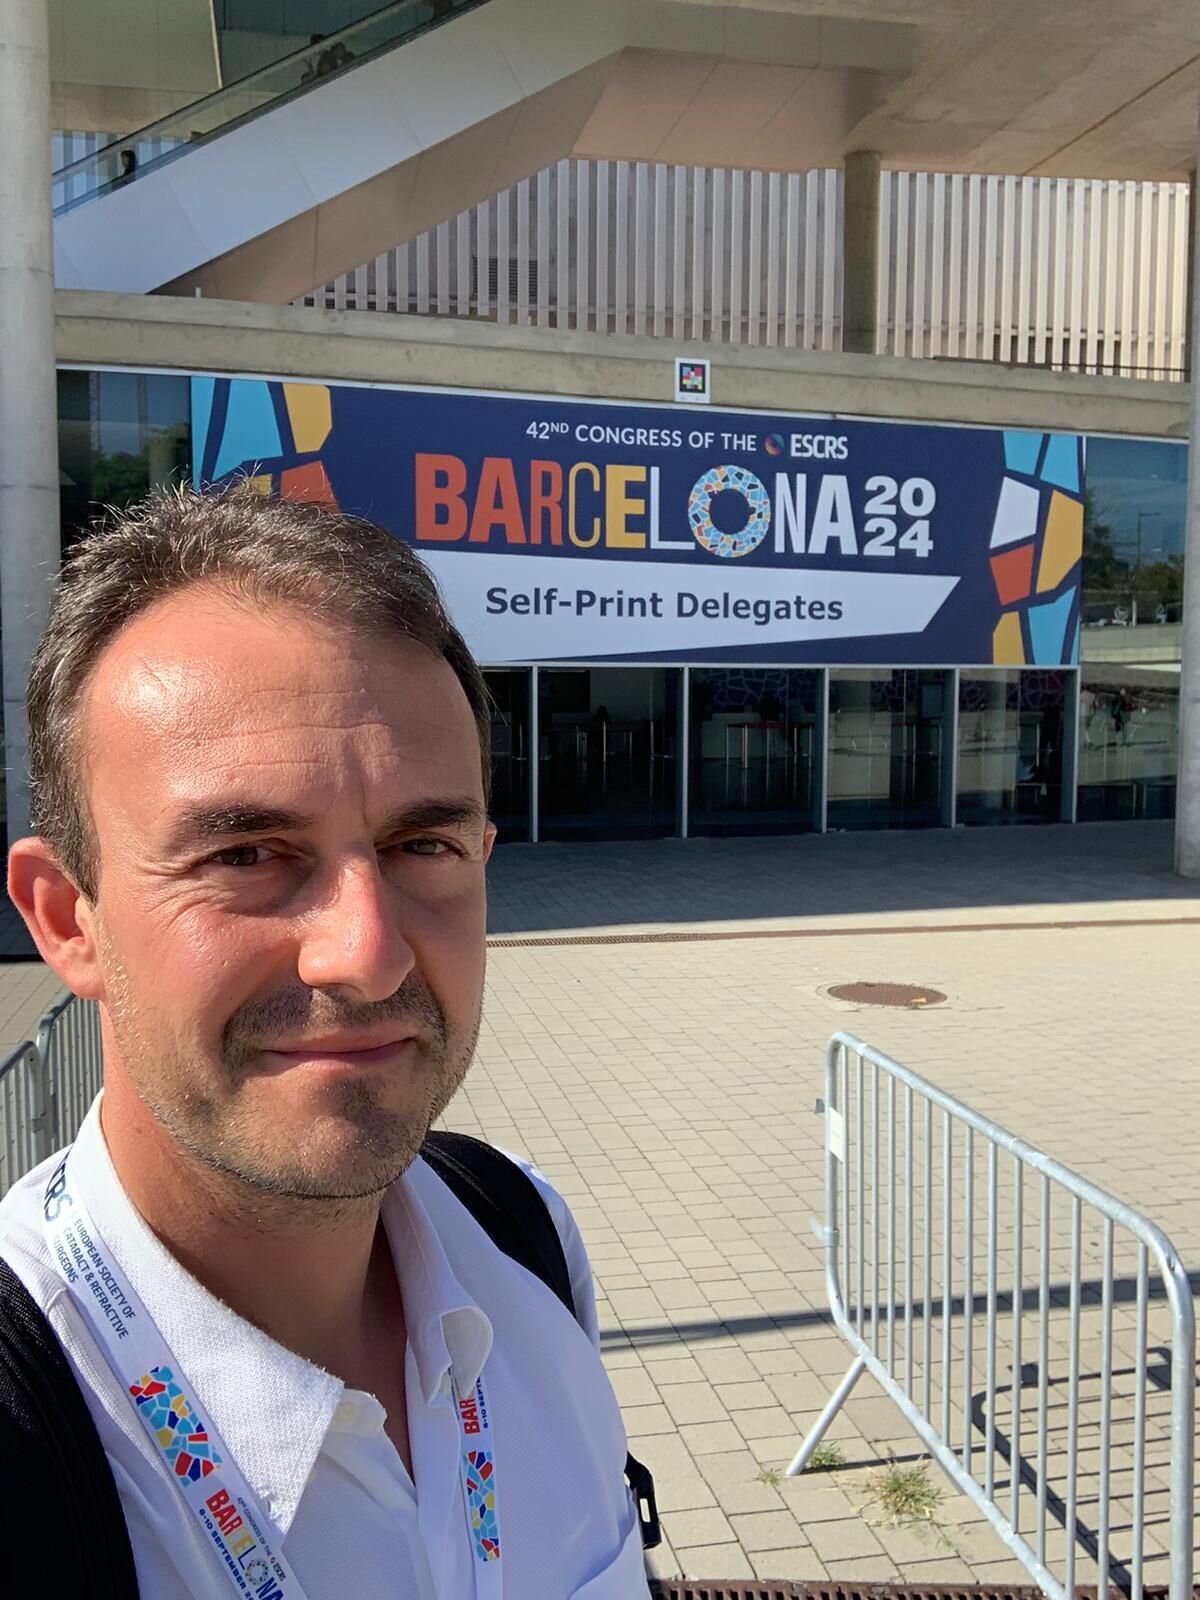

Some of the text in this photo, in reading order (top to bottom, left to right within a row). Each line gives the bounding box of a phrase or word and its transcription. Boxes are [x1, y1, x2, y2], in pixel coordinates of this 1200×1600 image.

[526, 421, 849, 460] 42ND CONGRESS OF THE ESCRS
[414, 452, 859, 558] BARCELONA
[485, 587, 844, 626] Self-Print Delegates
[53, 1235, 80, 1284] SURGEONS
[63, 1226, 129, 1341] CATARACT & REFRACTIVE
[74, 1218, 136, 1320] EUROPEAN SOCIETY OF
[210, 1530, 247, 1590] SEPTEMBER
